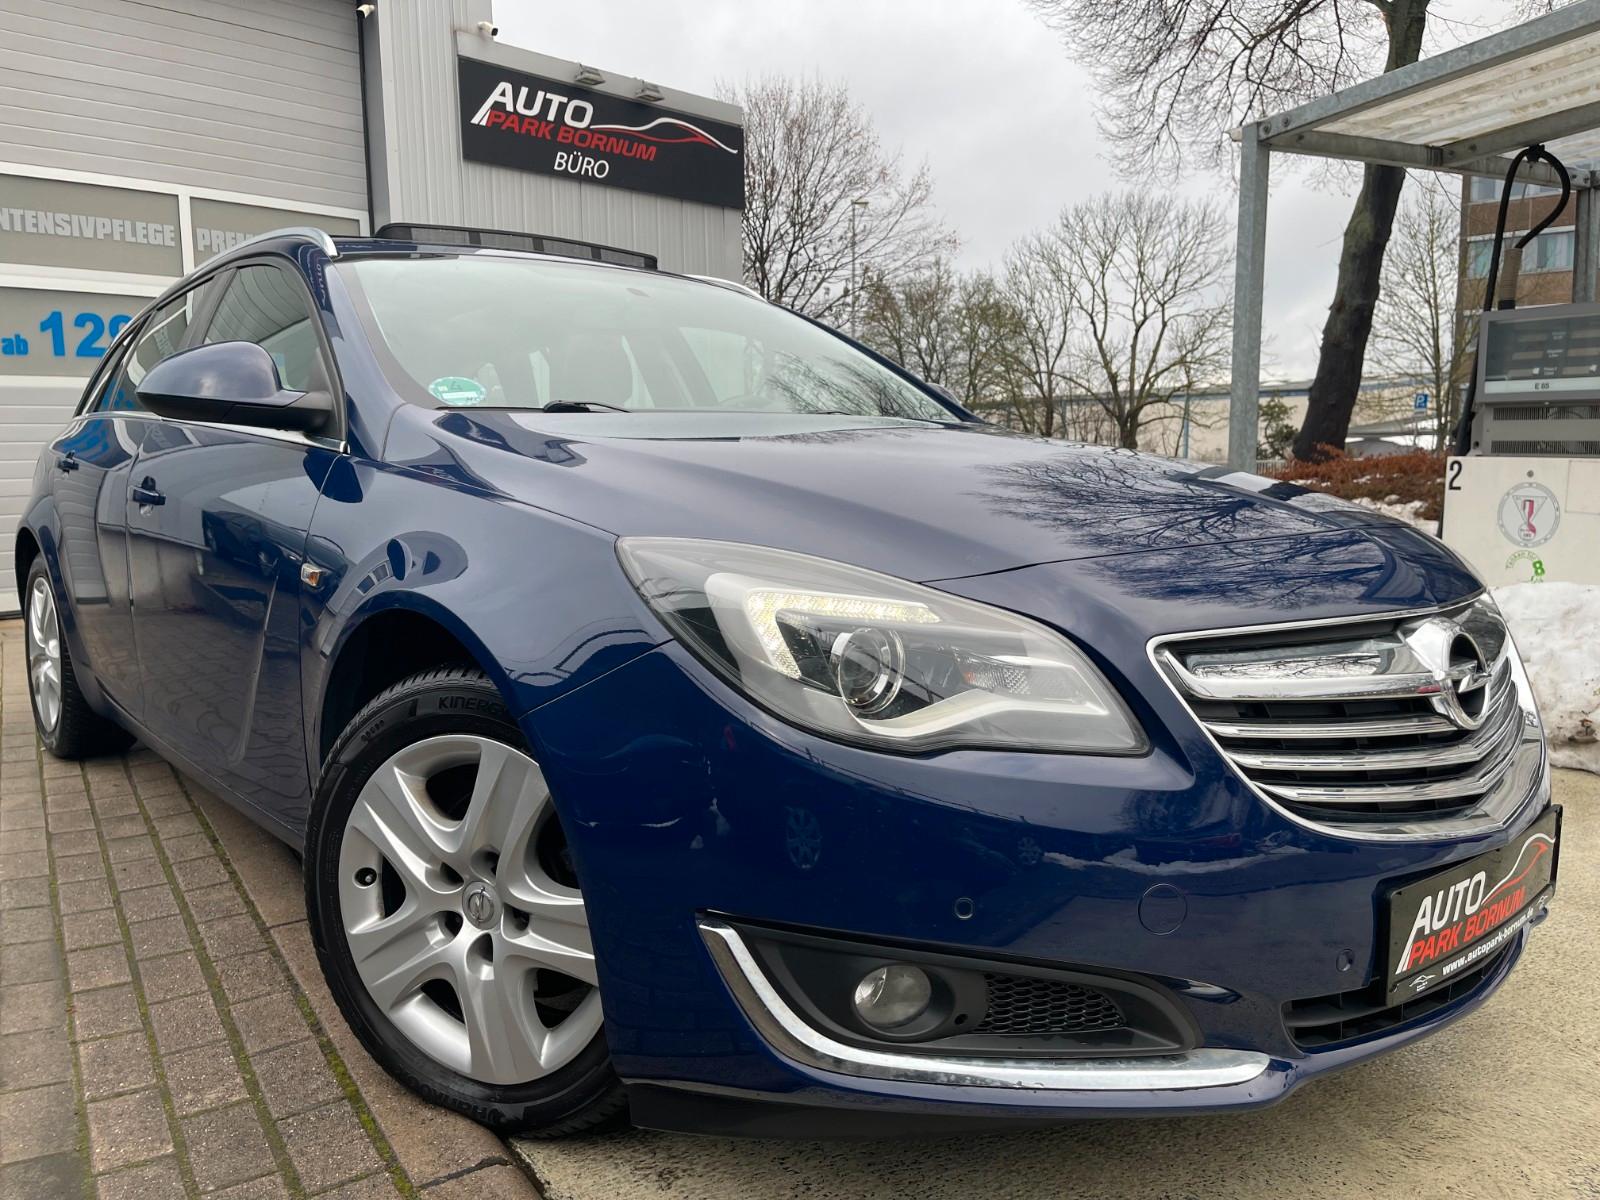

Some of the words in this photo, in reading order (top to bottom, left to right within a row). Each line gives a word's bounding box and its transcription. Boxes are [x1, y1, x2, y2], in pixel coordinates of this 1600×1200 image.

[470, 81, 594, 129] AUTO
[486, 110, 555, 140] PARK
[557, 126, 656, 161] BORNUM
[554, 151, 610, 179] BÜRO
[1, 334, 29, 356] ab
[1448, 460, 1462, 490] 2
[1395, 871, 1486, 975] AUTO
[1407, 921, 1463, 970] PARK
[1463, 886, 1526, 942] BORNUM
[1442, 907, 1534, 976] www.autopark-bornum.de
